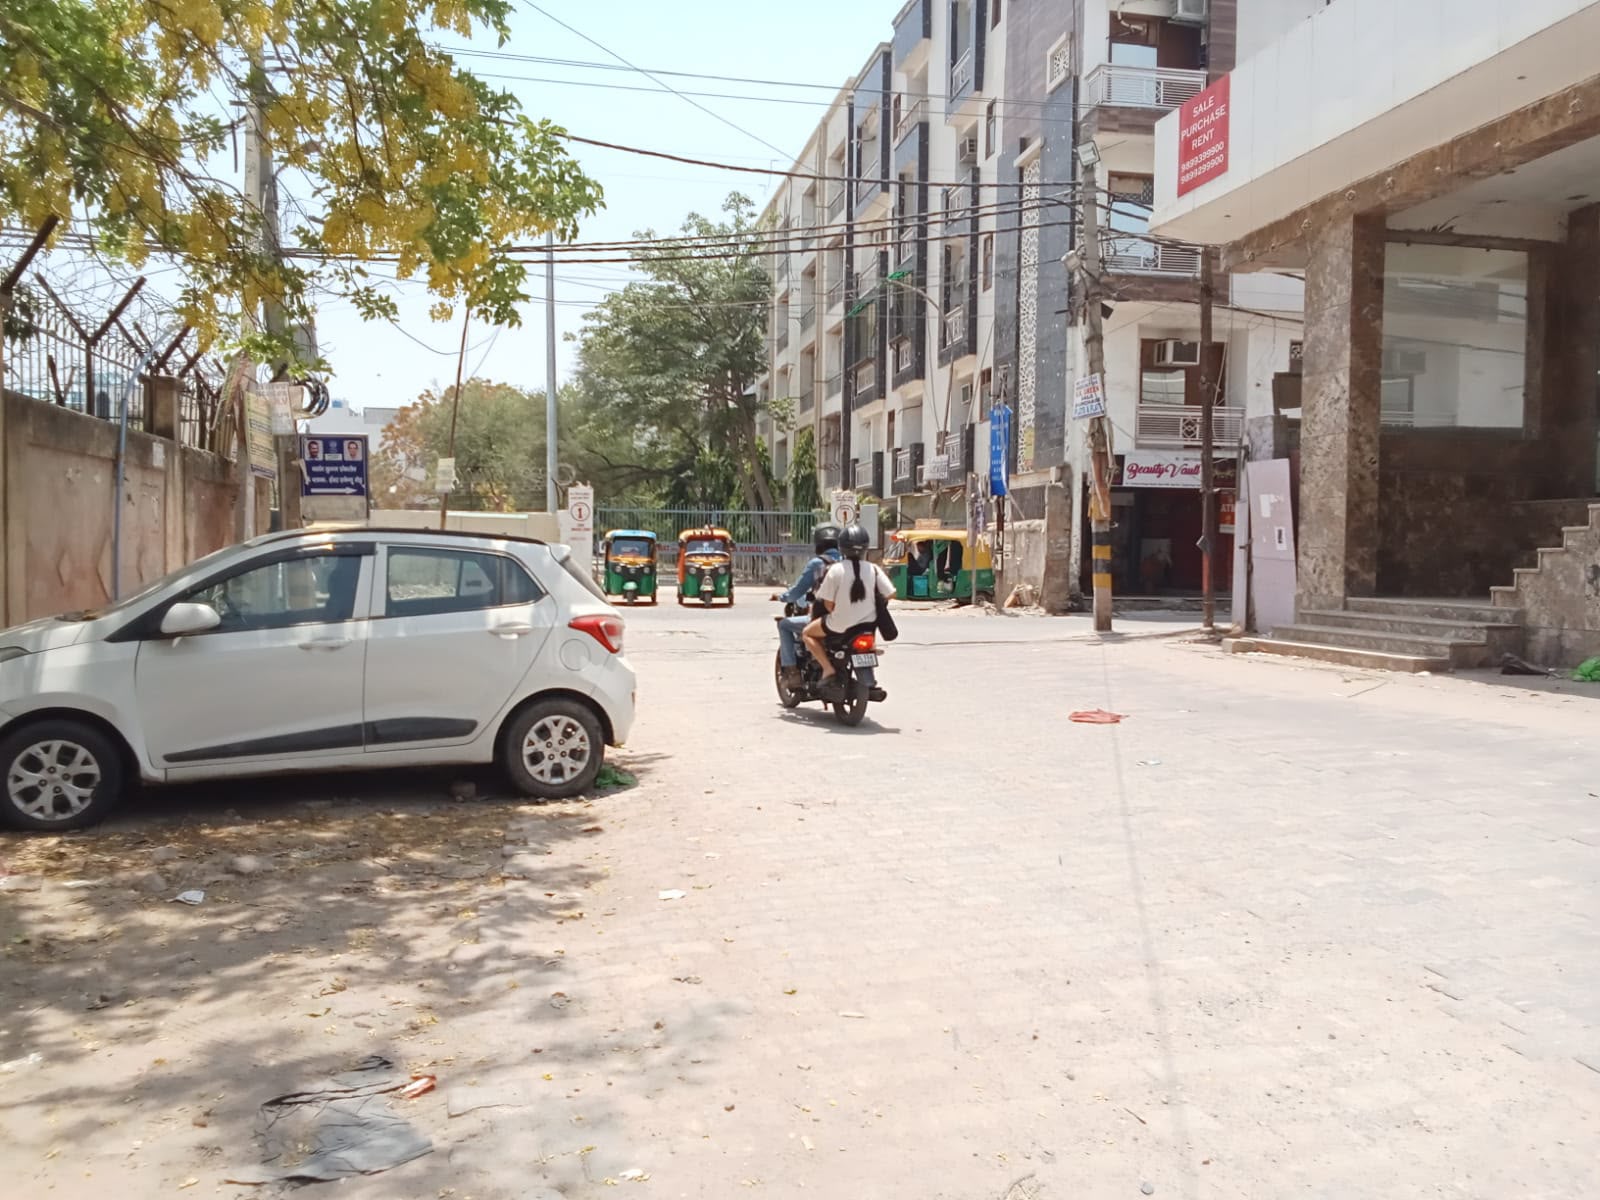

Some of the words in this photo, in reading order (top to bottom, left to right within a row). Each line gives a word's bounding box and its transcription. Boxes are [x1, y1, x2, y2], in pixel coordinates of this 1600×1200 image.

[1192, 96, 1215, 118] SALE
[1181, 104, 1226, 140] PURCHASE
[1192, 128, 1215, 150] RENT
[1127, 463, 1165, 479] Beauty
[578, 508, 583, 519] 1
